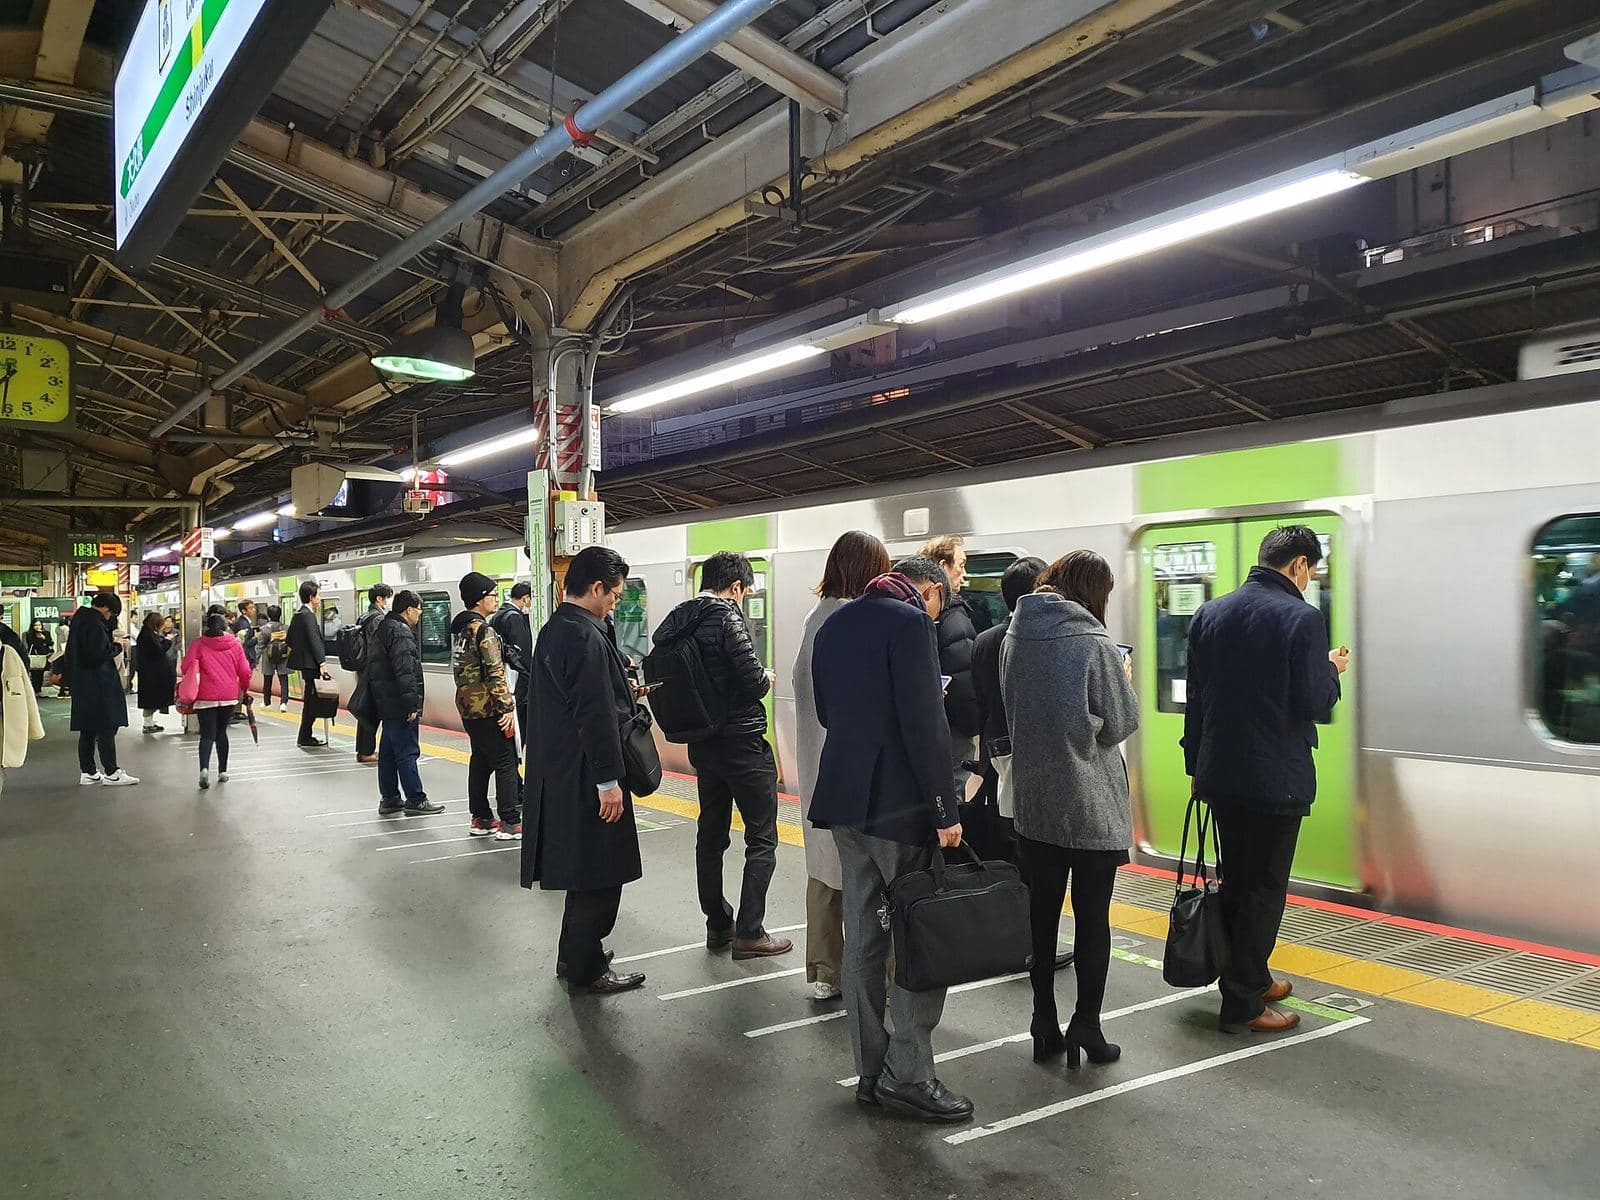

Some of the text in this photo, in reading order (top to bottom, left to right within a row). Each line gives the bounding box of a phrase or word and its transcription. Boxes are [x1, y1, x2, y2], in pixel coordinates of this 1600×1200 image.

[24, 346, 32, 355] 1
[40, 358, 51, 368] 2
[48, 376, 59, 386] 3
[40, 393, 49, 402] 4
[22, 402, 32, 412] 5
[124, 534, 135, 543] 15
